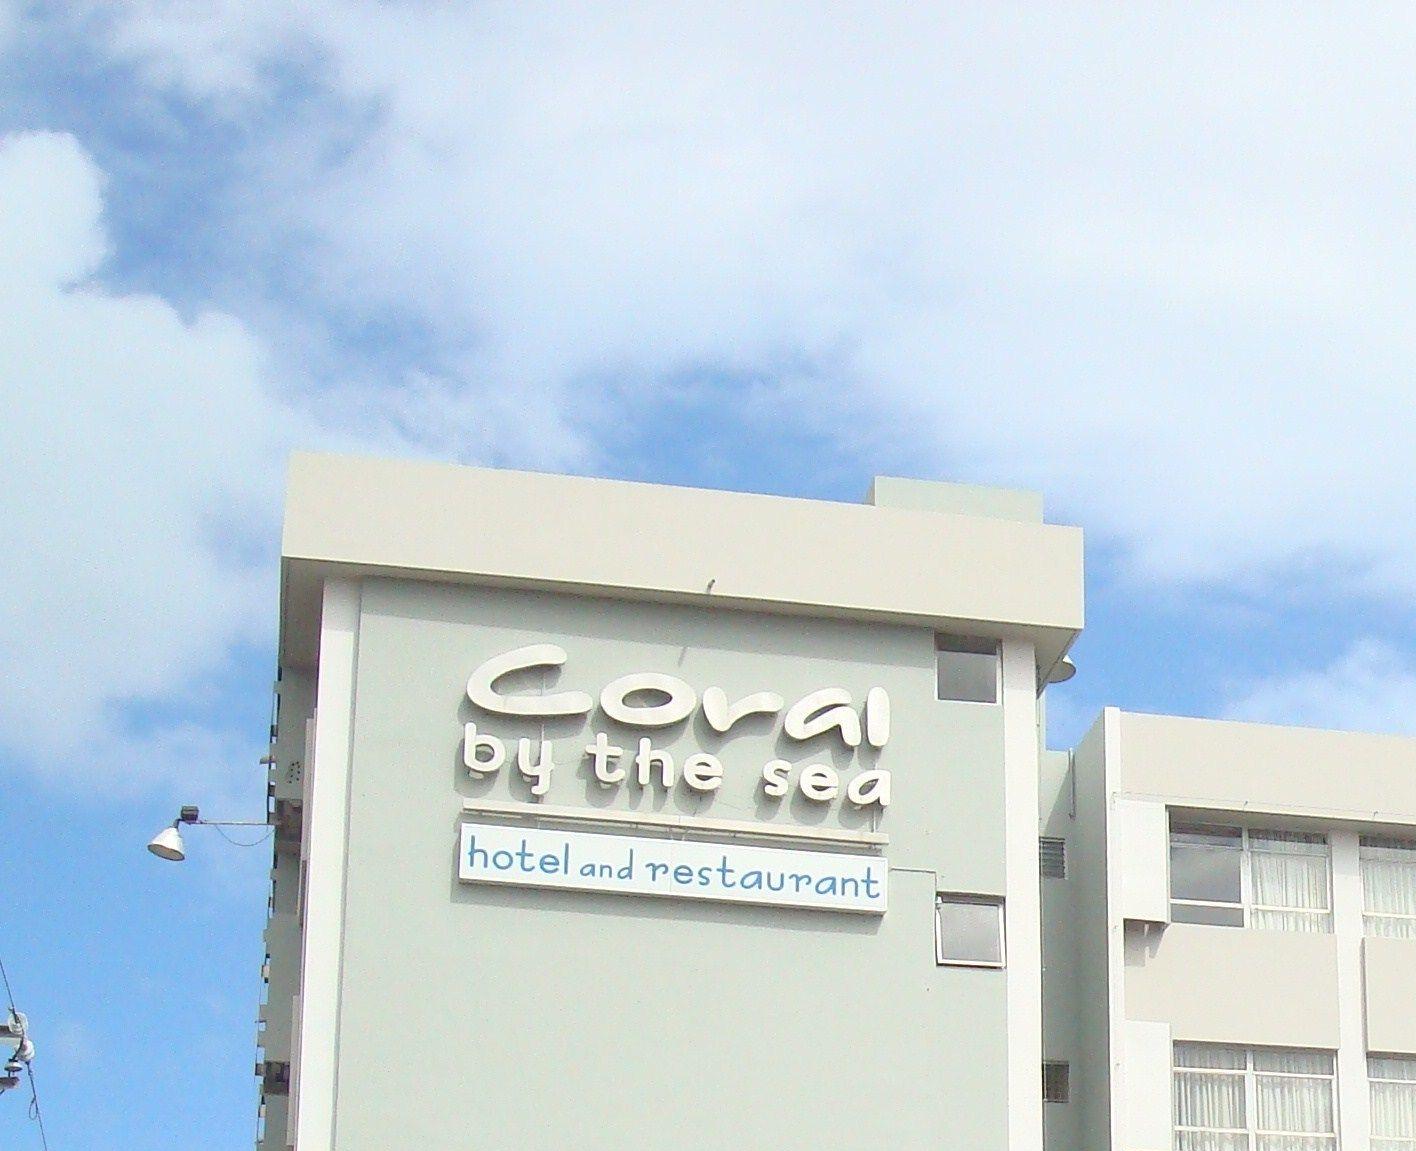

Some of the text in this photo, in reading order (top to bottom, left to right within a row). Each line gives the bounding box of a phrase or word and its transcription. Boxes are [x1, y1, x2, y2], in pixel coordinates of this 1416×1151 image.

[466, 643, 890, 747] Coral
[463, 723, 891, 806] by the sea
[469, 836, 880, 899] hotel and restaurant
